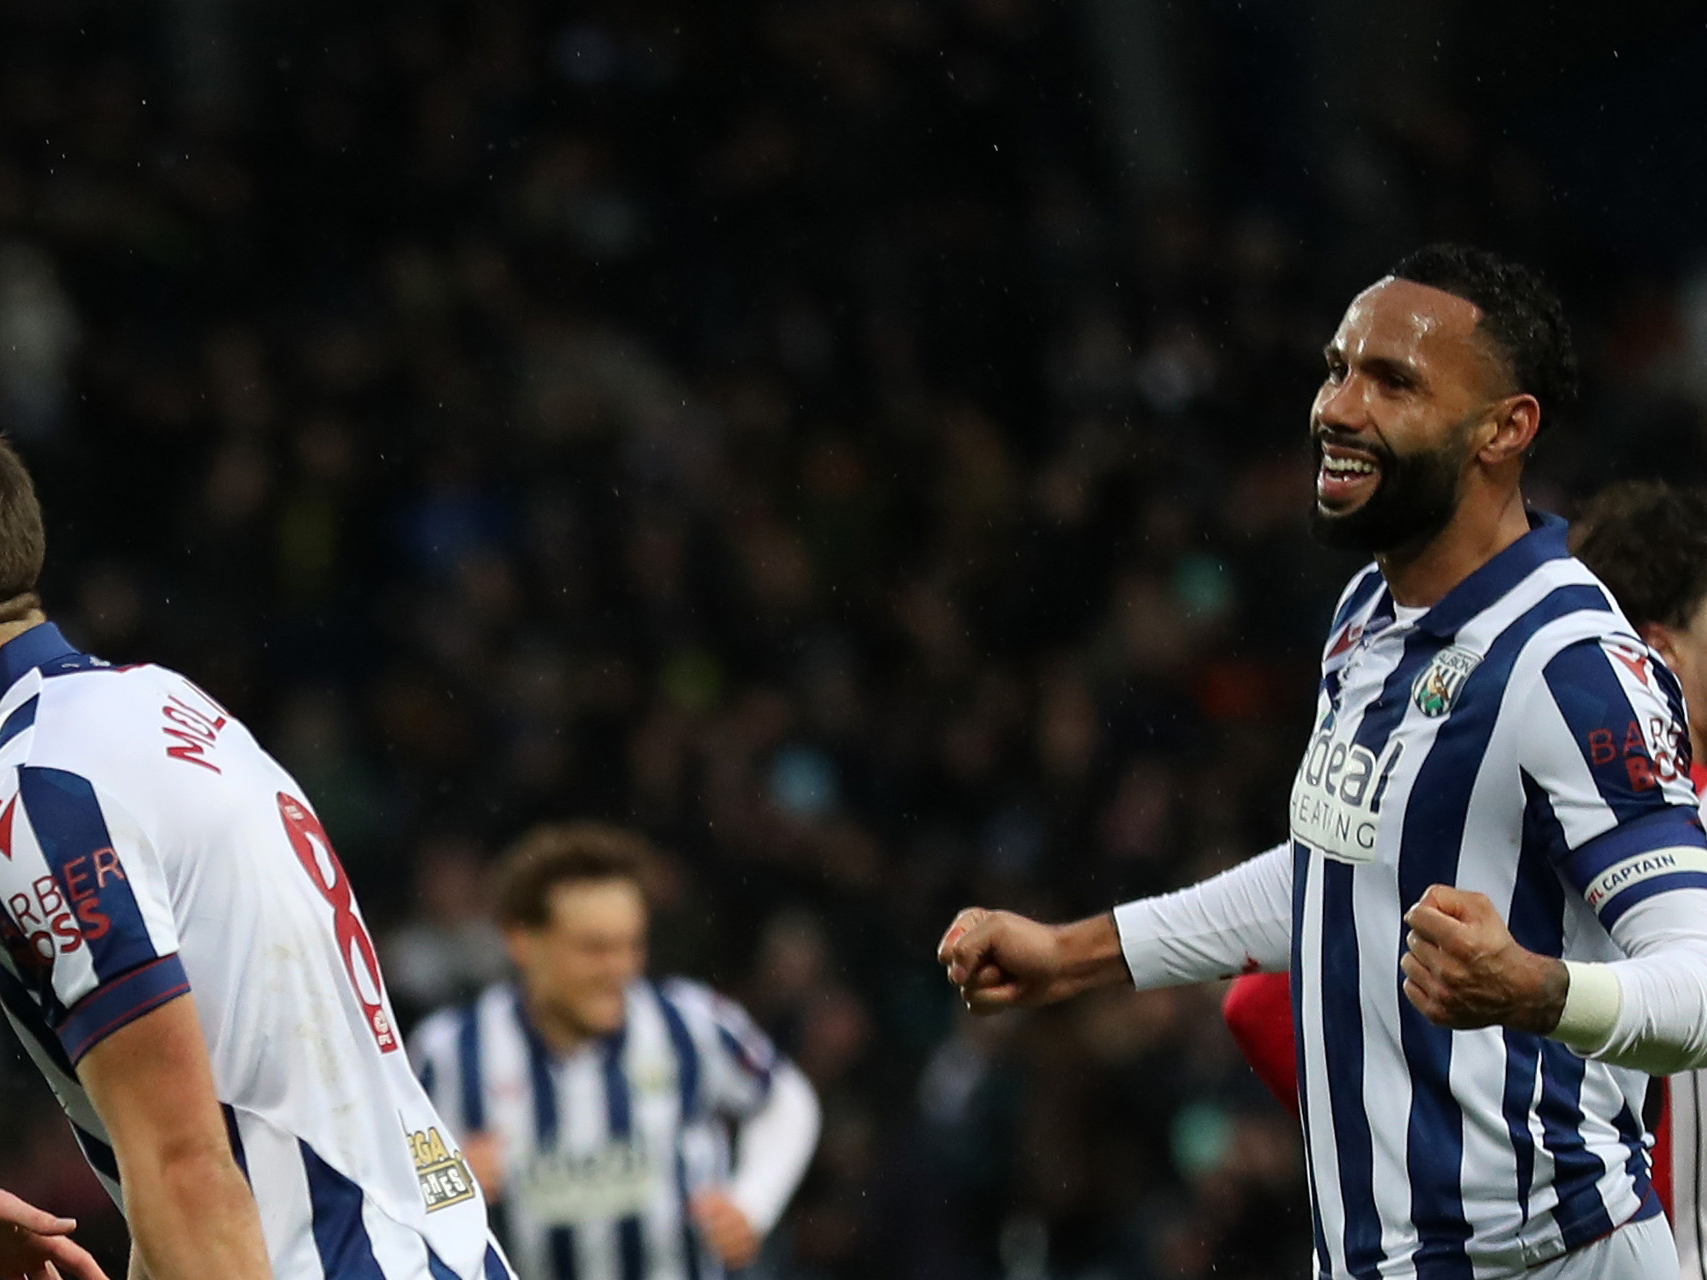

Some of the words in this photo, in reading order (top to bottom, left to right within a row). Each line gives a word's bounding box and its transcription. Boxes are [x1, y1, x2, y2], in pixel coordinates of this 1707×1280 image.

[161, 678, 228, 775] MOL
[8, 846, 126, 935] RBER
[1602, 854, 1677, 892] CAPTAIN
[29, 897, 112, 966] OSS
[275, 790, 399, 1053] 8
